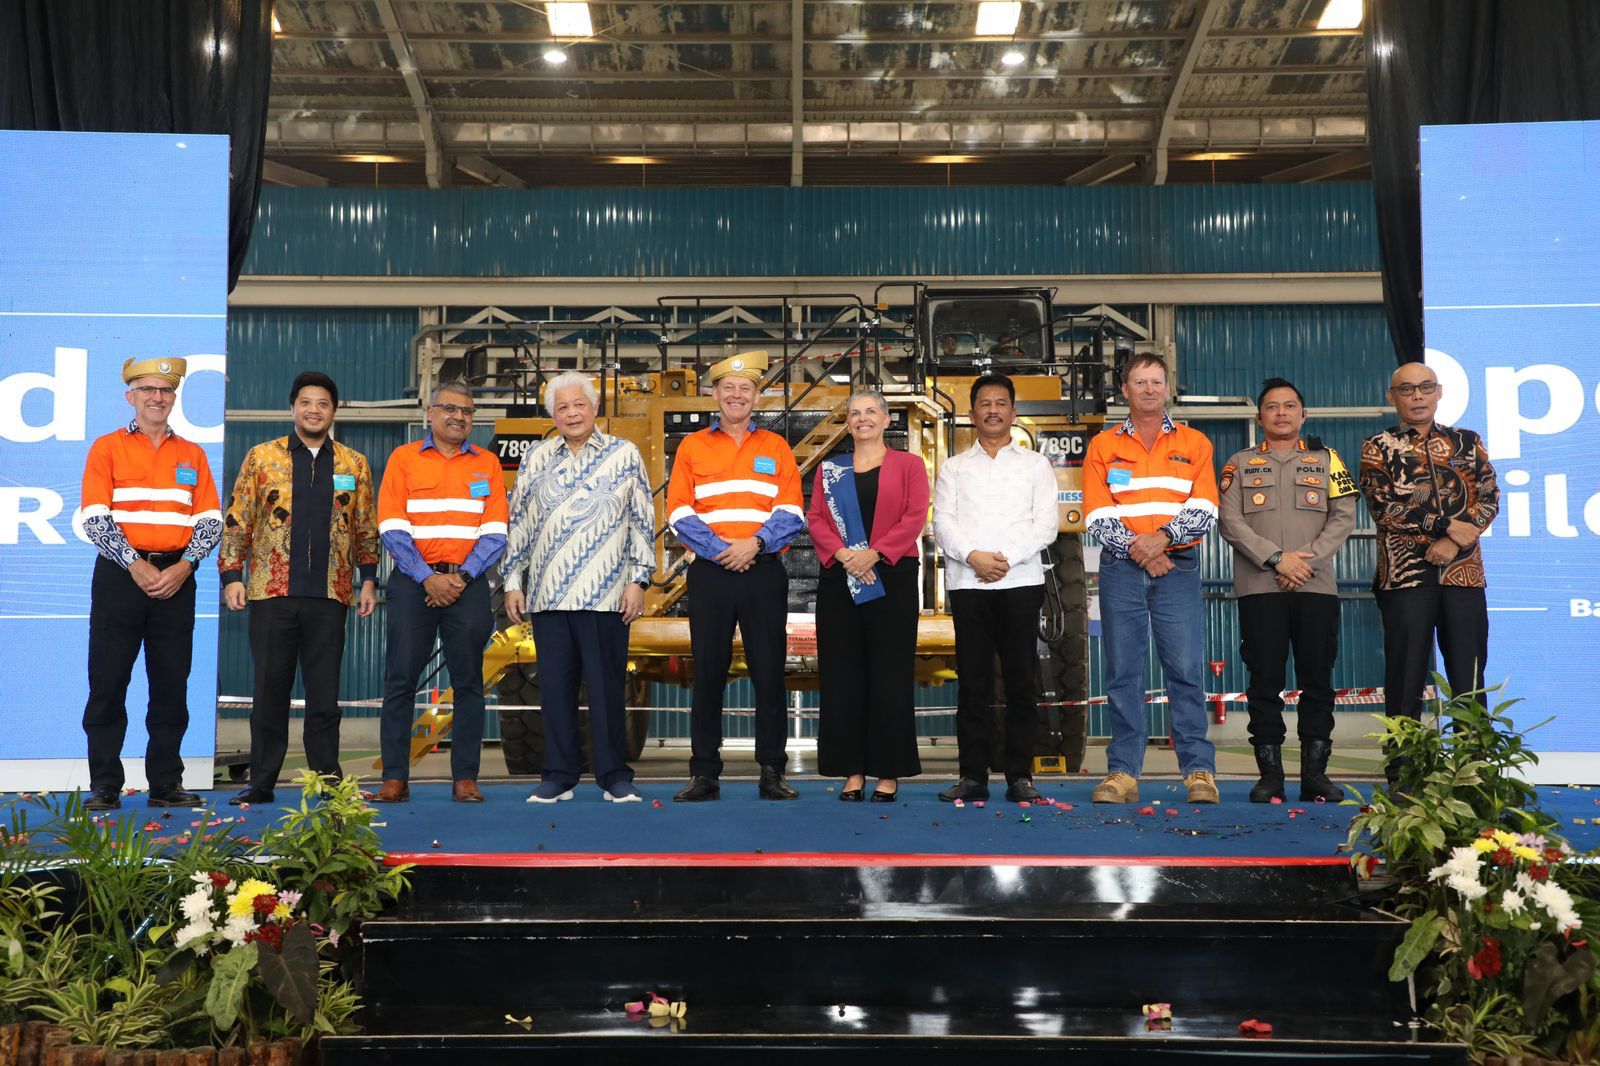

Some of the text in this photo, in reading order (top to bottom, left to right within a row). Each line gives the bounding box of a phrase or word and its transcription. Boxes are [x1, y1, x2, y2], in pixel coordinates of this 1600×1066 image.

[498, 440, 536, 458] 789
[1038, 436, 1083, 455] 789C
[1296, 466, 1325, 474] POLRI
[1480, 469, 1600, 538] il
